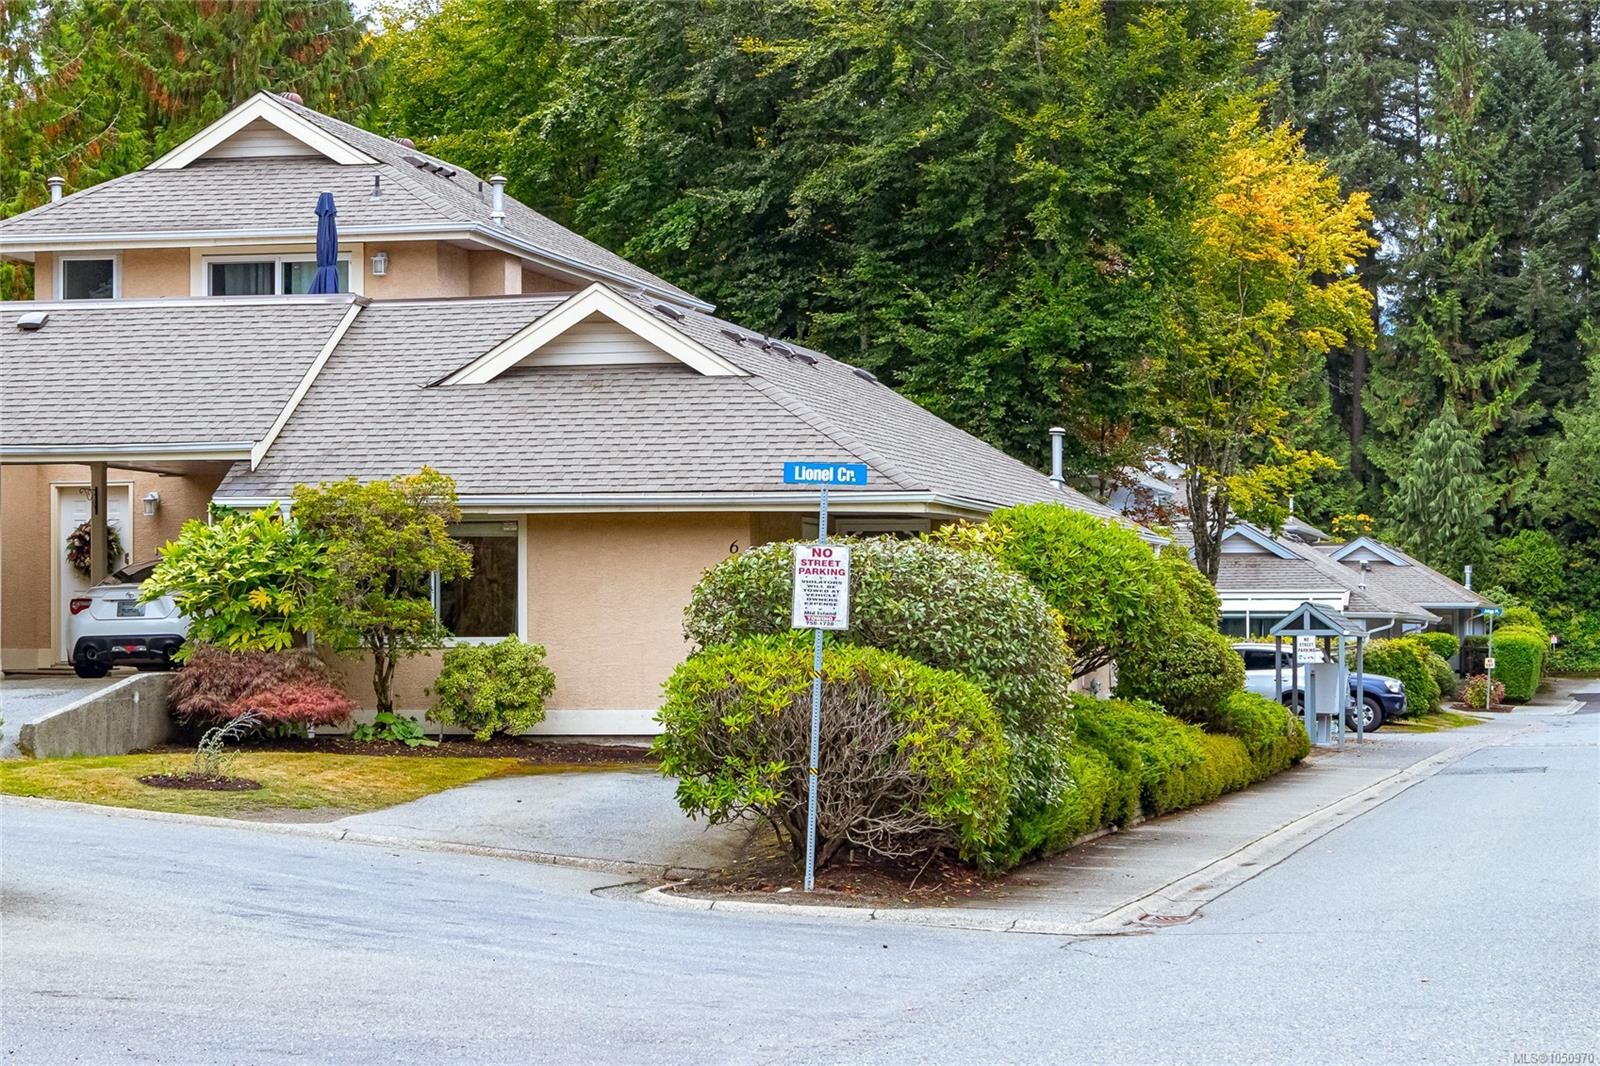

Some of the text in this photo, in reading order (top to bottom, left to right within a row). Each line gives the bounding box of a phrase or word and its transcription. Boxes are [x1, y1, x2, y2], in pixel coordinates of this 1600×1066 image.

[794, 465, 857, 483] Lionel Cr.
[729, 539, 739, 554] 6
[811, 547, 833, 558] NO
[800, 559, 841, 567] STREET
[798, 567, 846, 576] PARKING
